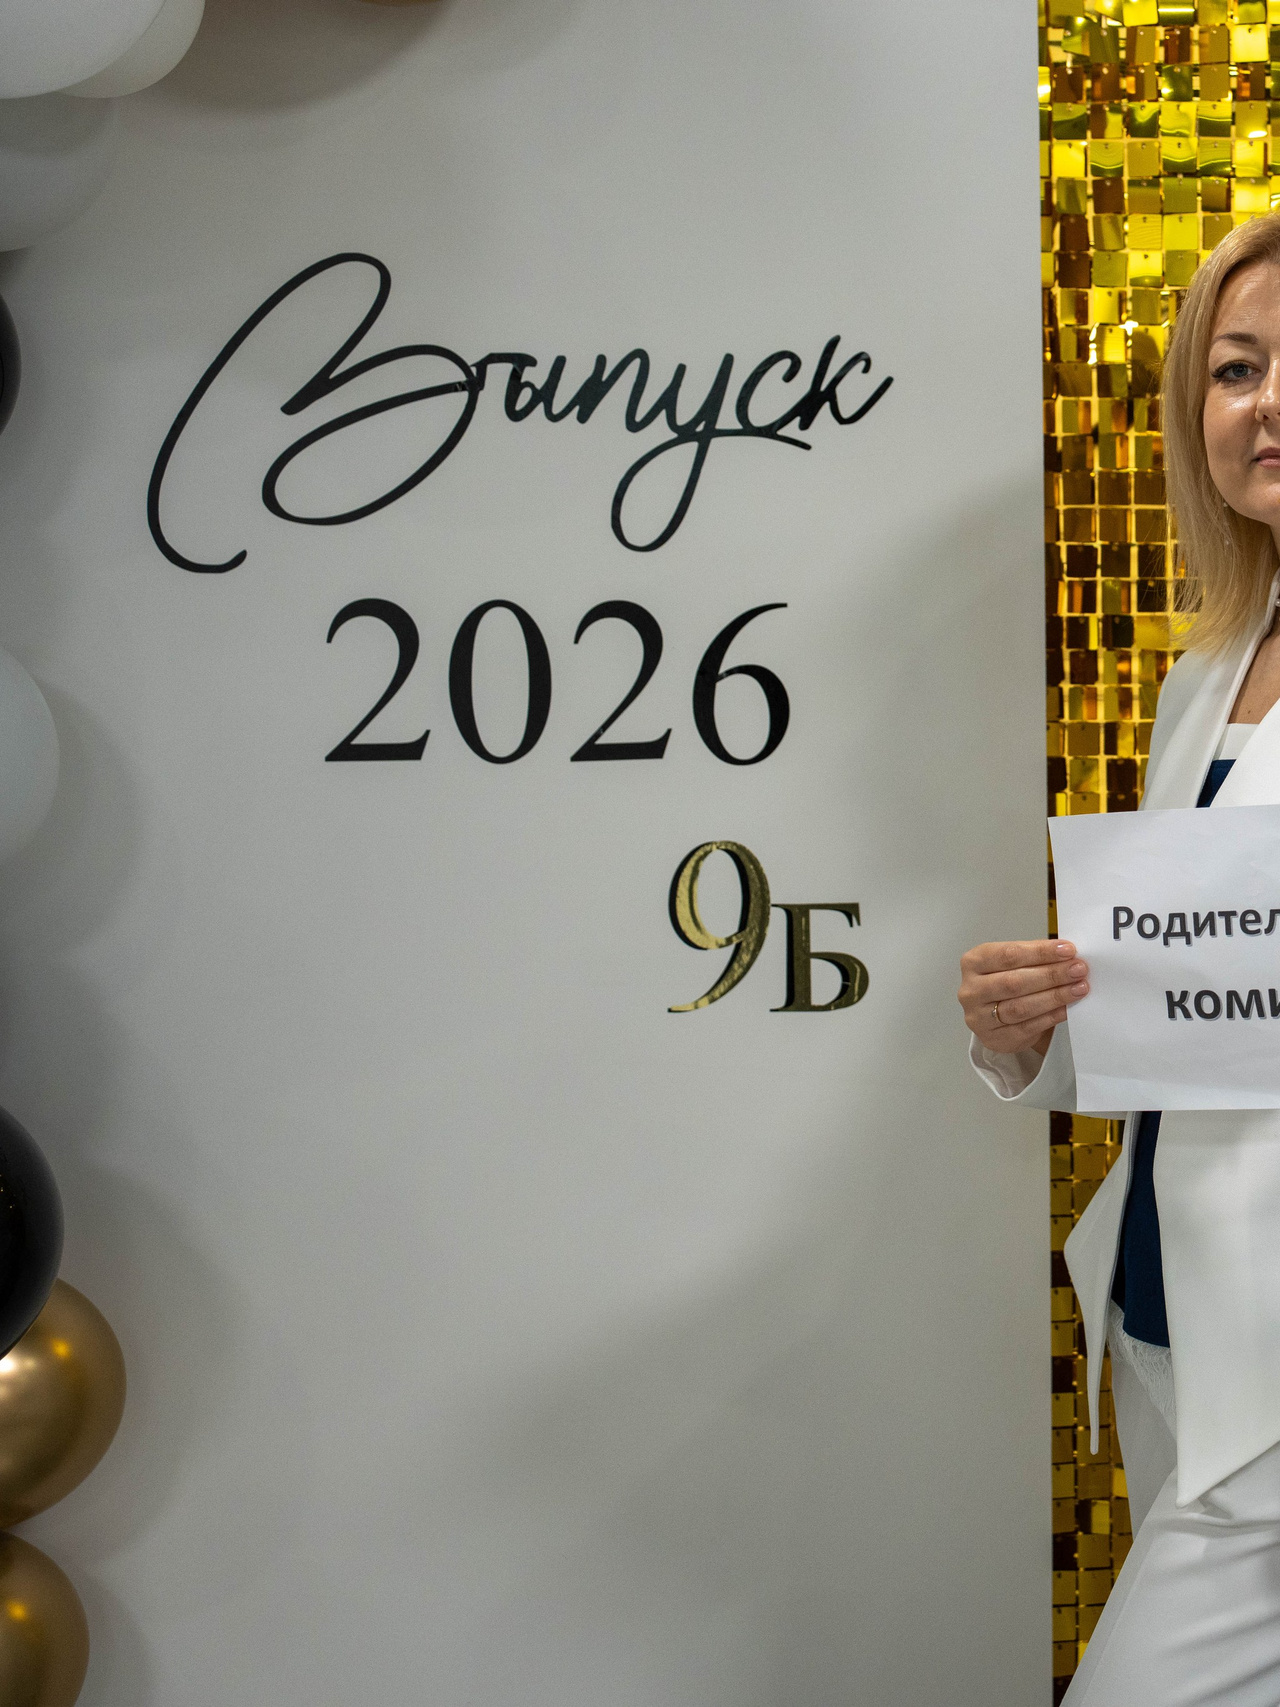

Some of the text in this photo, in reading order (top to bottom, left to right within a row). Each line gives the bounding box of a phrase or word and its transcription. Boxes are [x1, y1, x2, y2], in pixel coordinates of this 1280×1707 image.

[147, 252, 894, 574] Выпуск
[324, 597, 792, 766] 2026
[667, 840, 870, 1013] 9Б
